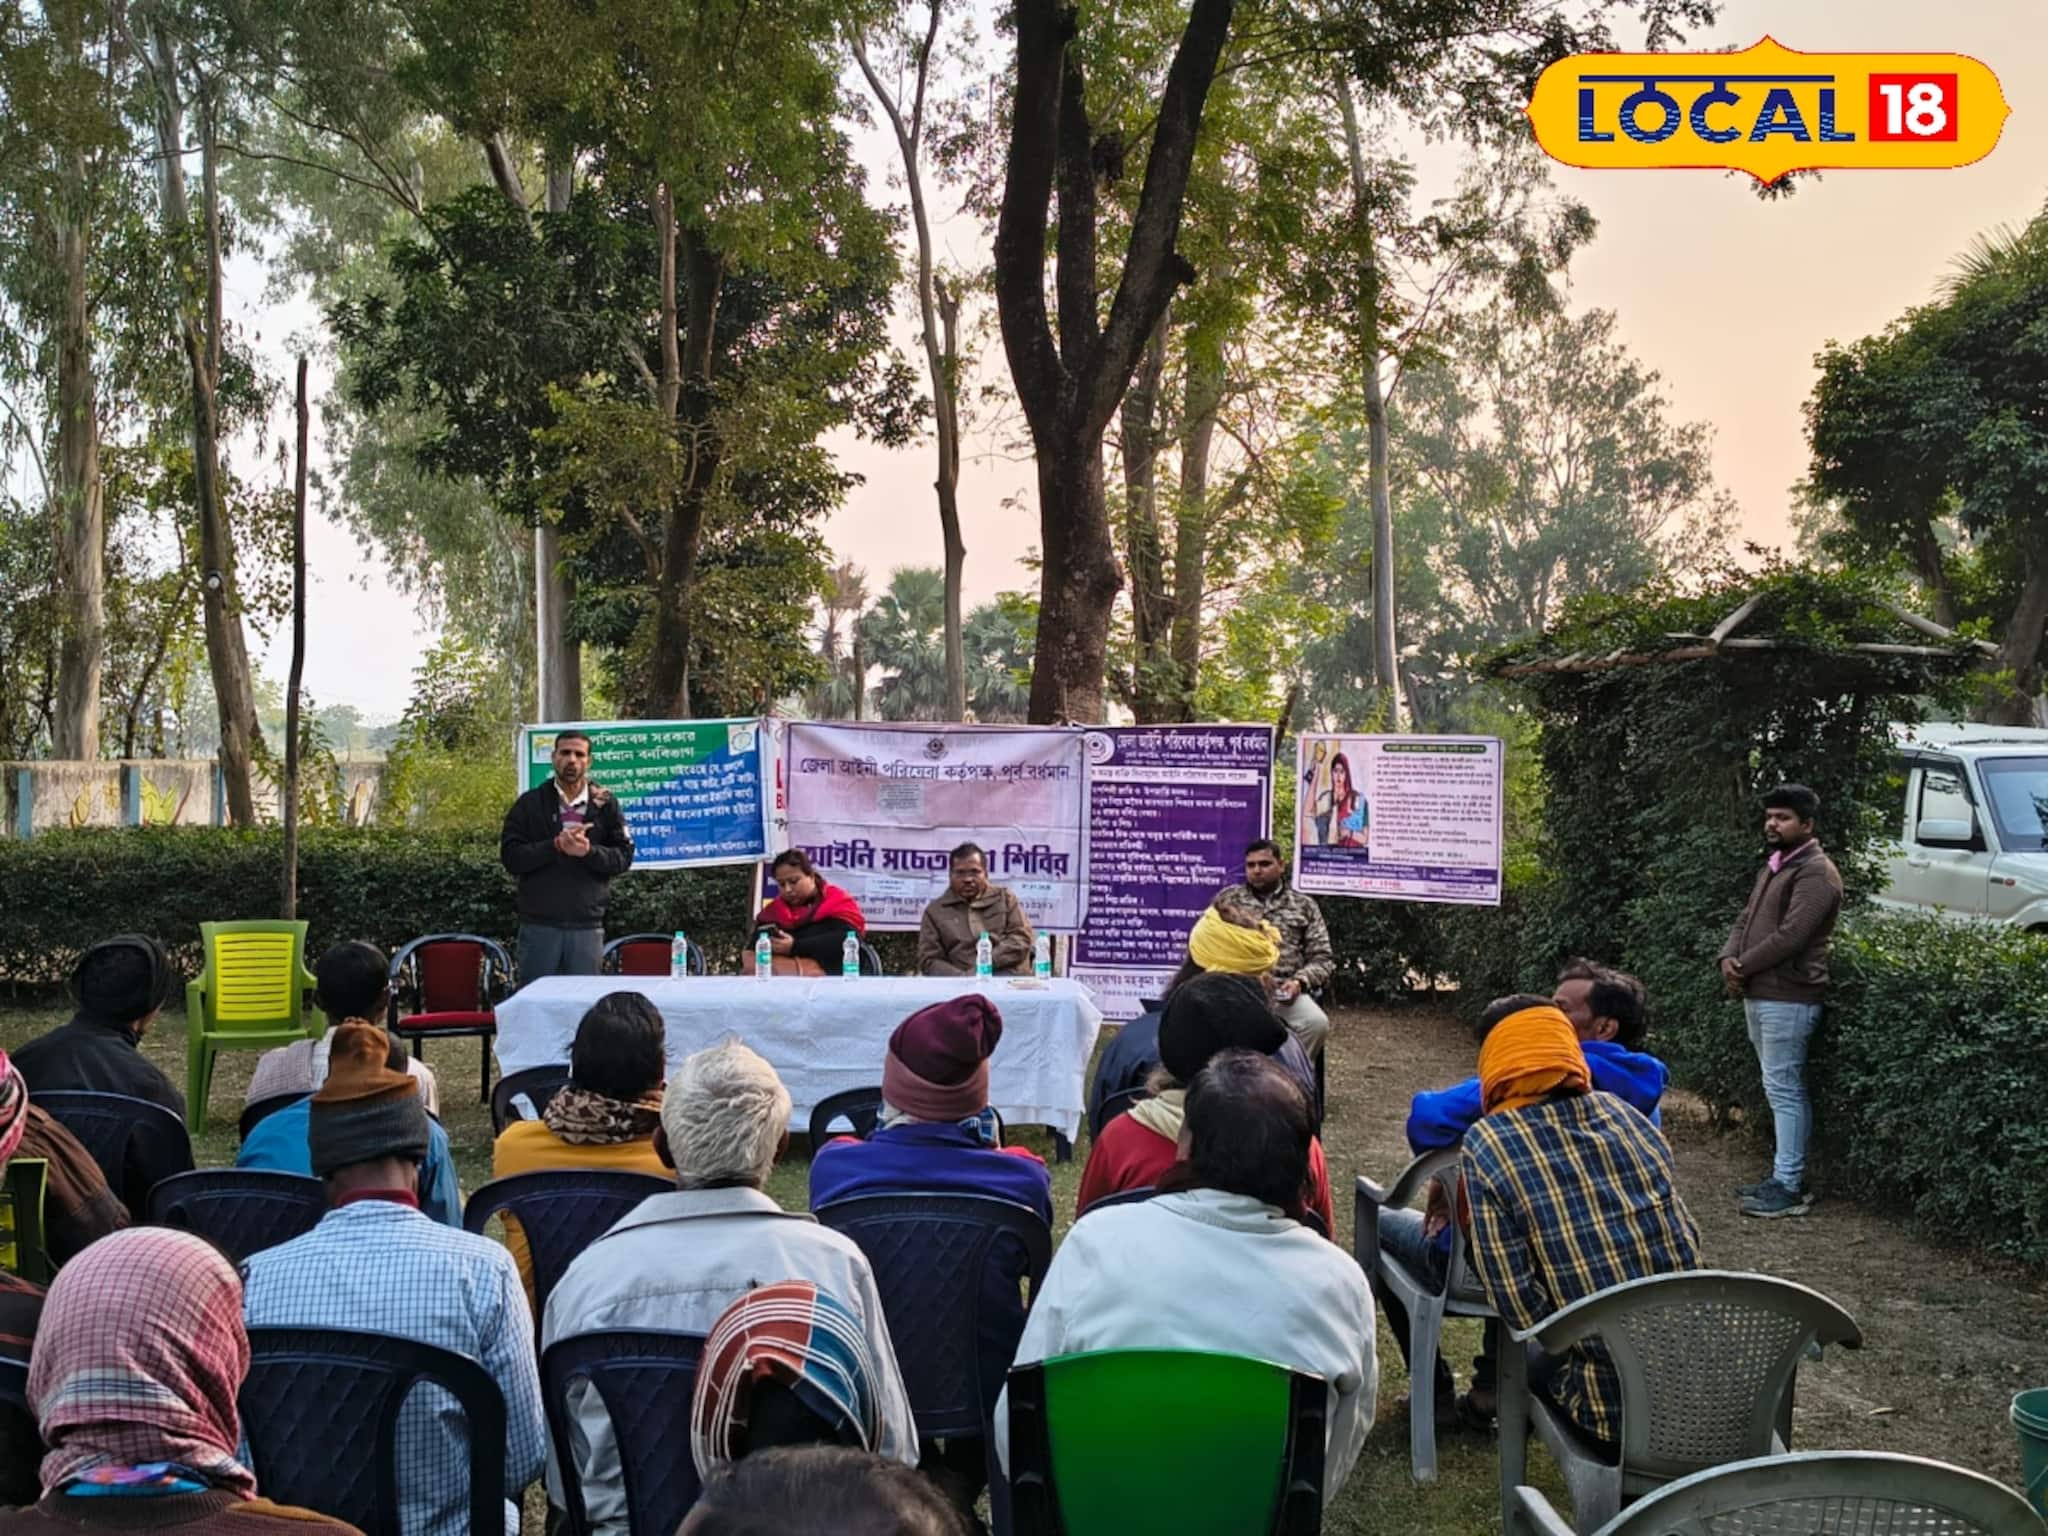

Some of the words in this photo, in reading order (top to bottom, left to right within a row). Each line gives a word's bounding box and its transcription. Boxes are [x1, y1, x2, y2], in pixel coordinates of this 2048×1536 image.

[651, 731, 696, 743] সরকার
[590, 747, 634, 761] বর্ধমান
[801, 758, 834, 775] জেলা
[883, 759, 939, 779] পরিষেবা
[1002, 760, 1026, 784] পূর্ব
[1026, 760, 1070, 780] বর্ধমান
[796, 839, 875, 871] আইনি
[1003, 845, 1069, 879] শিবির
